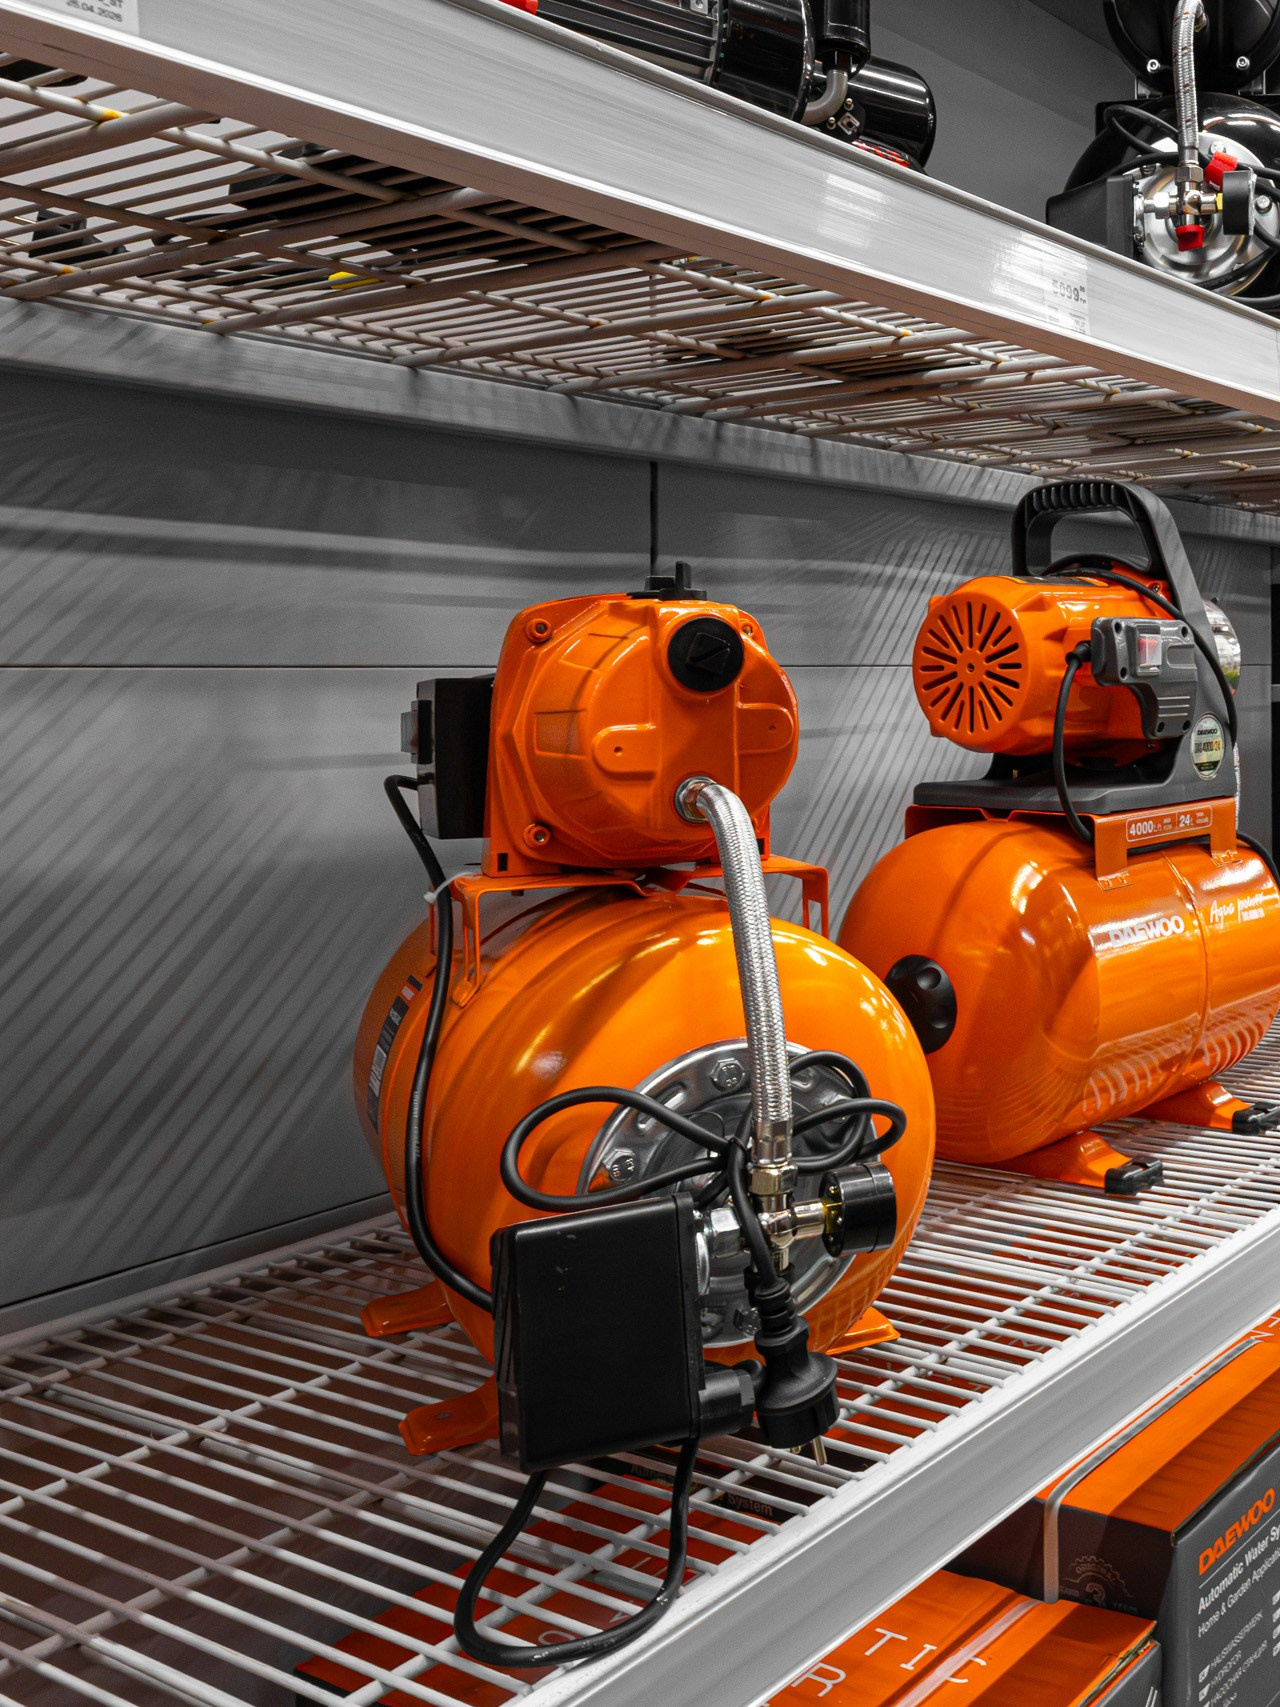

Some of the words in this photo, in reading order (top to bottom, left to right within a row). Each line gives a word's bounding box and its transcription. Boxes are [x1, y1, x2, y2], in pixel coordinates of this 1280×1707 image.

[1109, 915, 1185, 948] DAEWOO
[1210, 900, 1235, 929] Aqua
[1199, 1488, 1275, 1576] DAEWOO
[1198, 1562, 1243, 1614] Automatic
[1245, 1535, 1269, 1566] Water
[1198, 1611, 1220, 1637] Home
[1227, 1578, 1251, 1608] Garden
